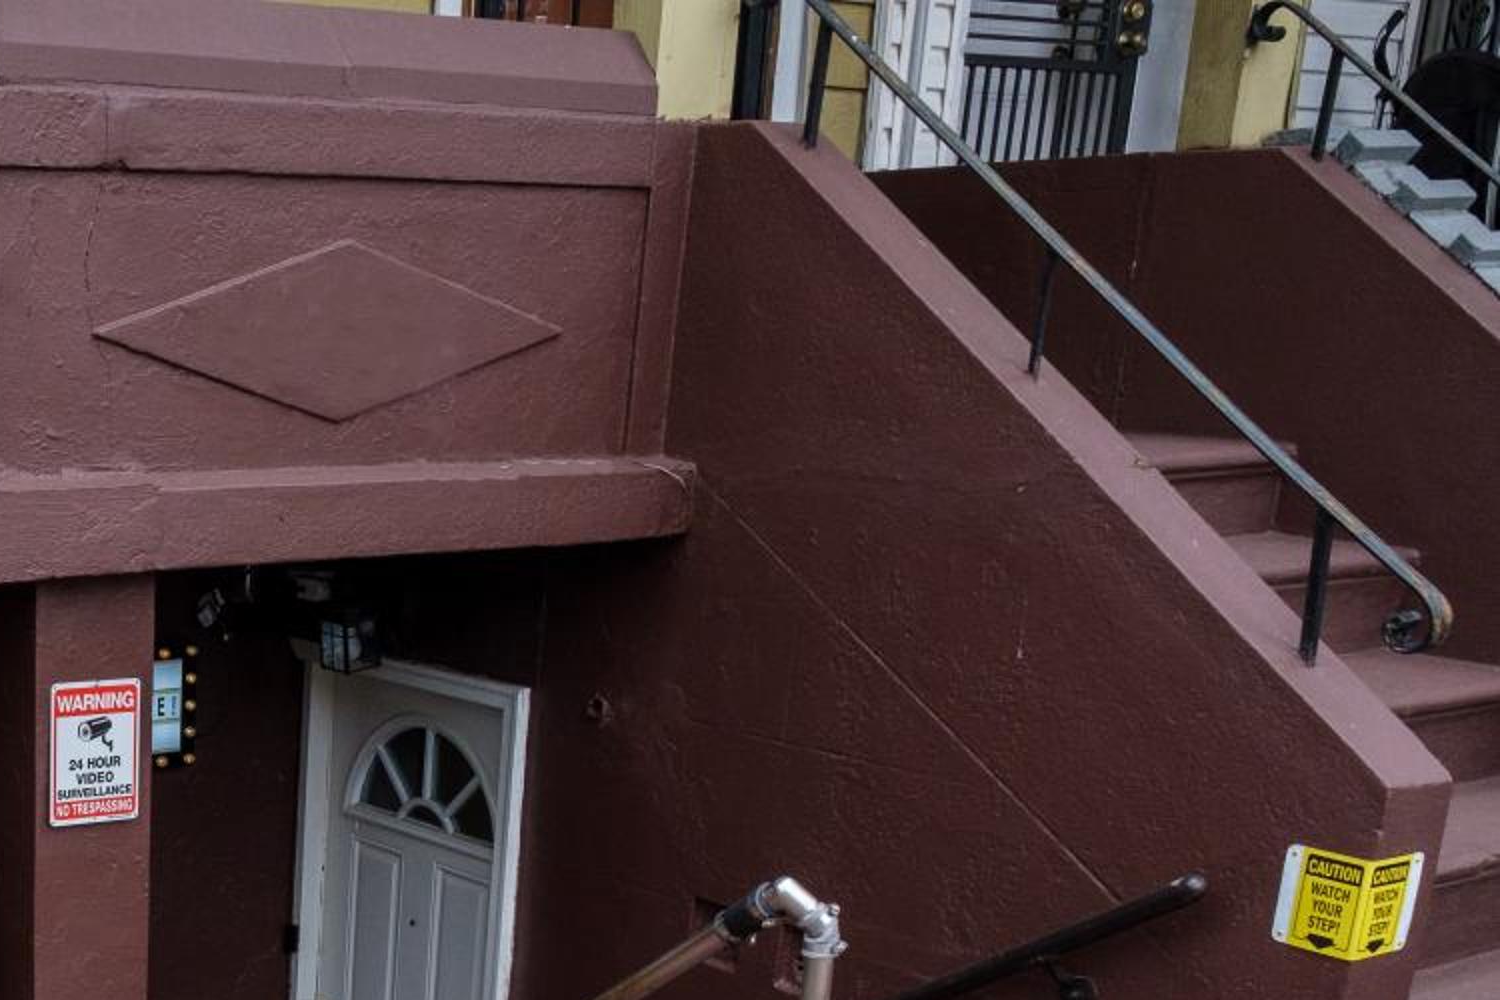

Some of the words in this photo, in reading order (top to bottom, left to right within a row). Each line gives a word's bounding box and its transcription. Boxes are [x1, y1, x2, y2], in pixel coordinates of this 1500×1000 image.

[57, 691, 134, 713] WARNING
[68, 758, 83, 771] 24
[87, 755, 121, 769] HOUR
[76, 771, 114, 784] VIDEO
[57, 784, 132, 800] SURVEILLANCE
[56, 804, 68, 817] NO
[72, 797, 133, 816] TRESPASSING
[1309, 858, 1362, 884] CAUTION
[1311, 881, 1350, 903] WATCH
[1313, 900, 1343, 919] YOUR
[1307, 915, 1341, 936] STEP!
